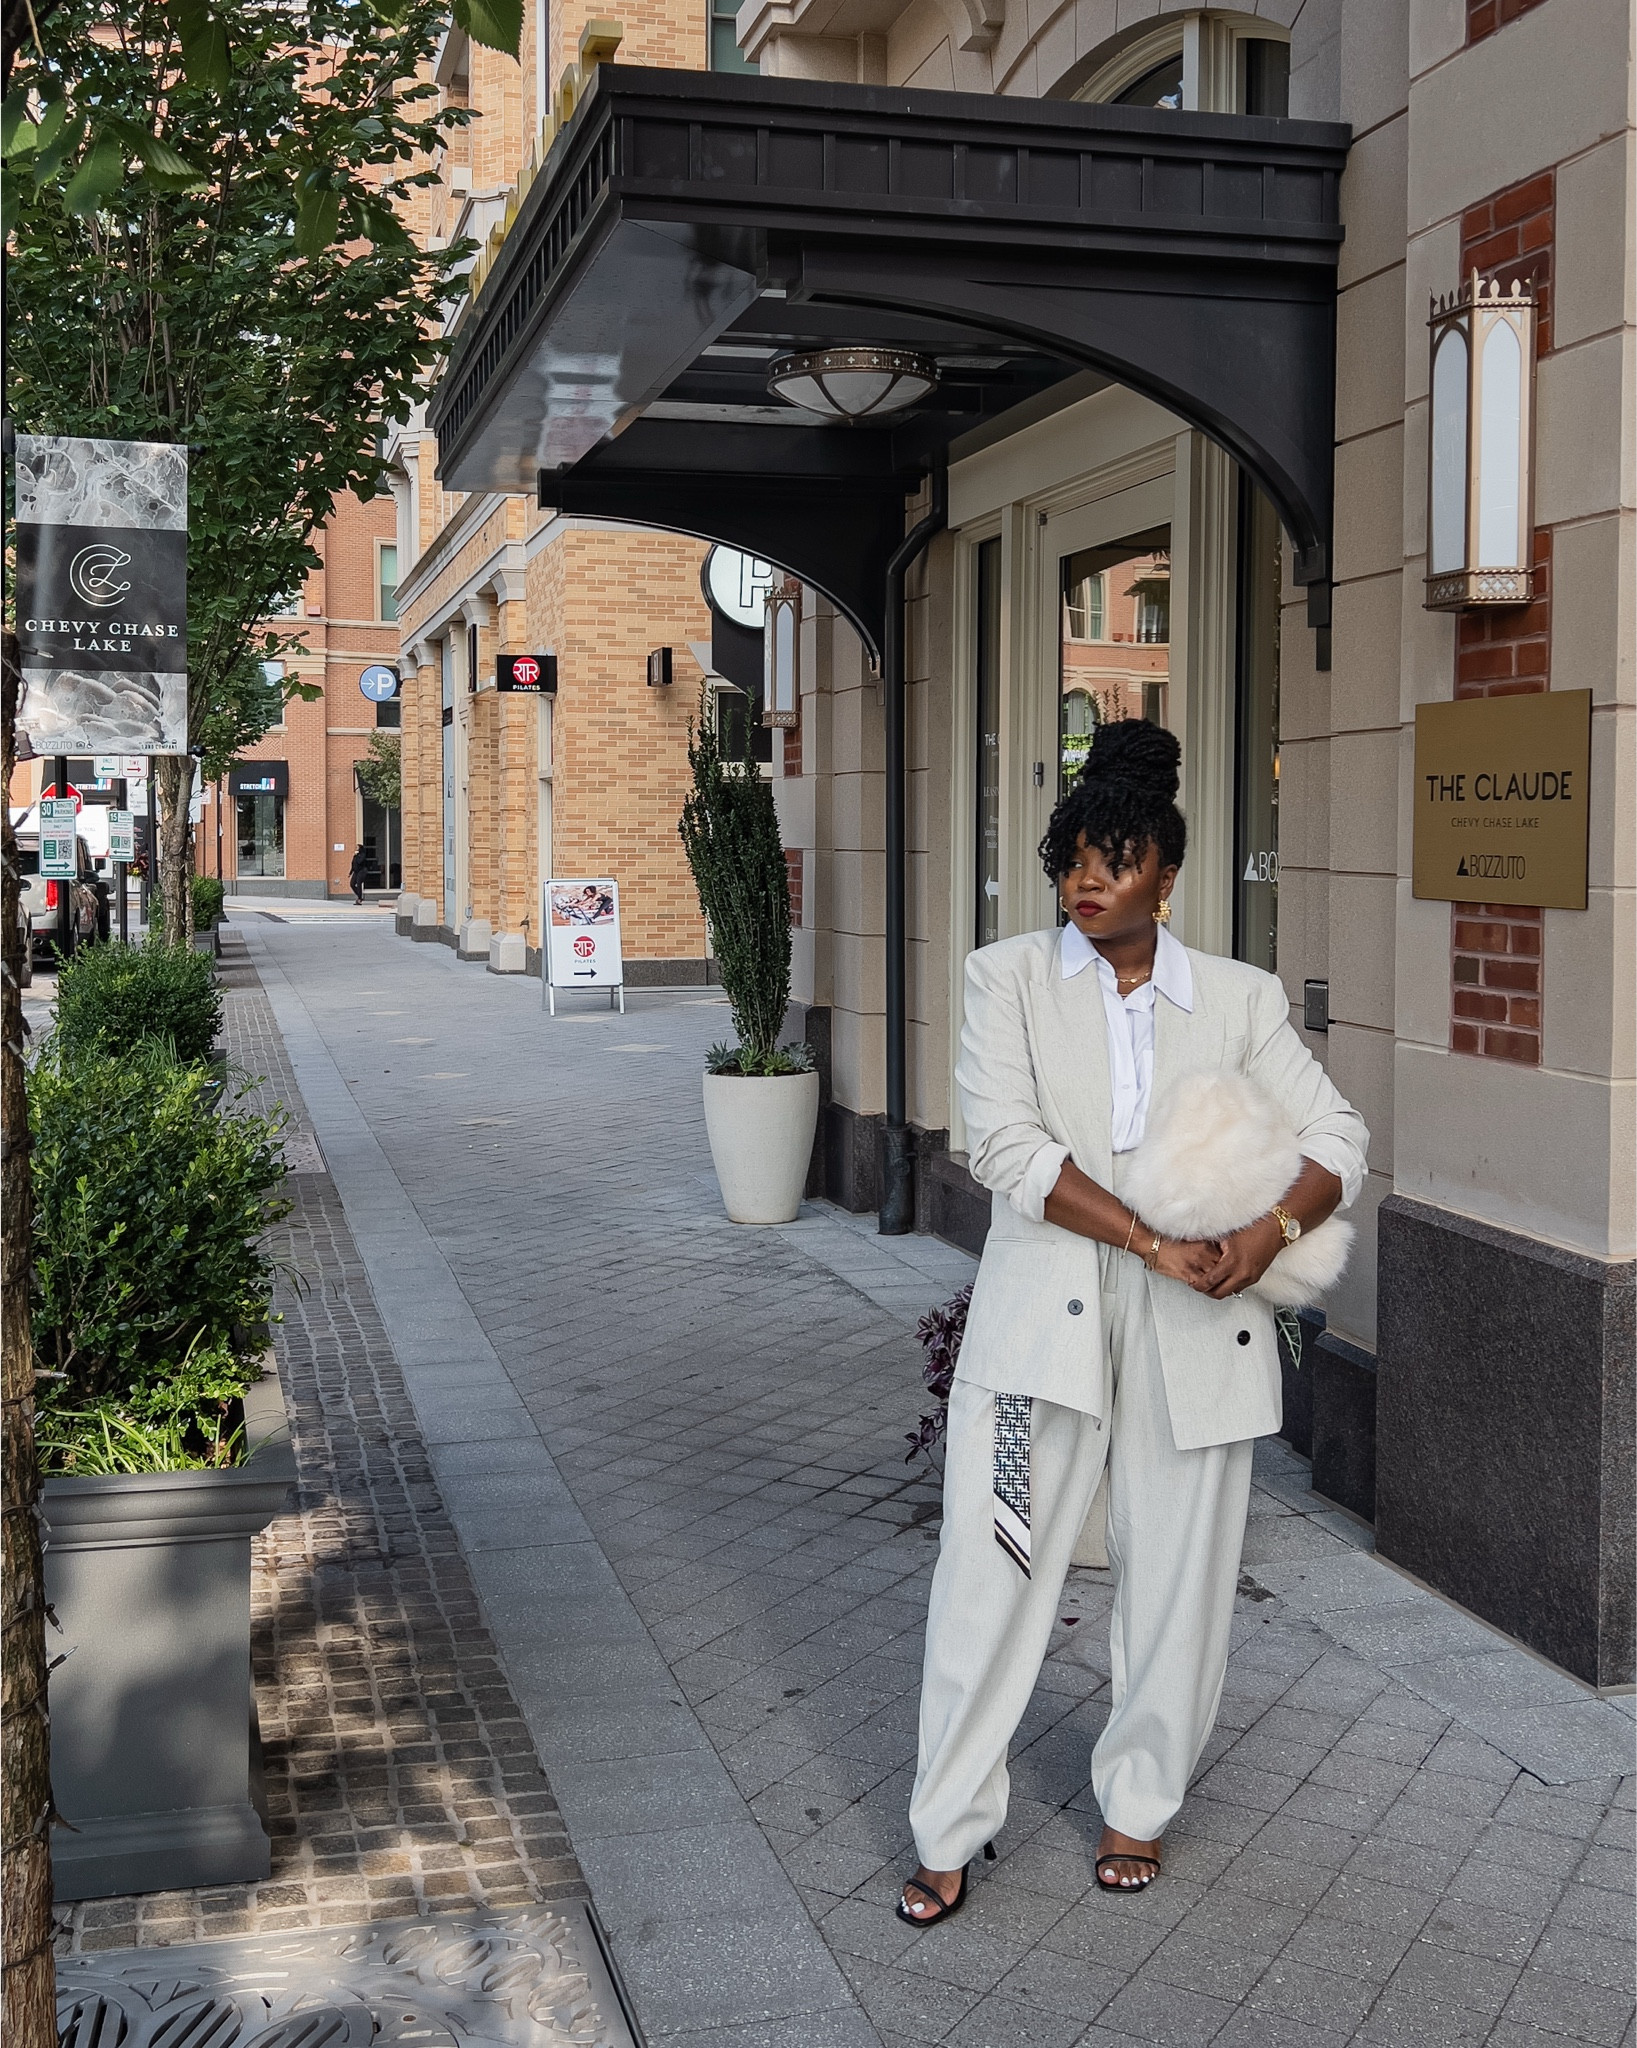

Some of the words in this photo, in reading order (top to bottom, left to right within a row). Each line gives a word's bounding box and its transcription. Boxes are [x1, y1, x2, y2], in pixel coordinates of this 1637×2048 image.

[24, 619, 101, 635] CHEVY
[108, 622, 179, 638] CHASE
[73, 637, 132, 652] LAKE
[377, 673, 394, 695] P
[984, 733, 997, 746] THE
[1426, 774, 1466, 801] THE
[1474, 770, 1573, 801] CLAUDE
[41, 802, 52, 816] 30
[110, 812, 118, 822] 15
[1451, 817, 1480, 828] CHEVY
[1483, 817, 1513, 828] CHASE
[1516, 817, 1540, 828] LAKE
[1259, 851, 1279, 882] BO
[1469, 854, 1526, 880] BOZZUTO
